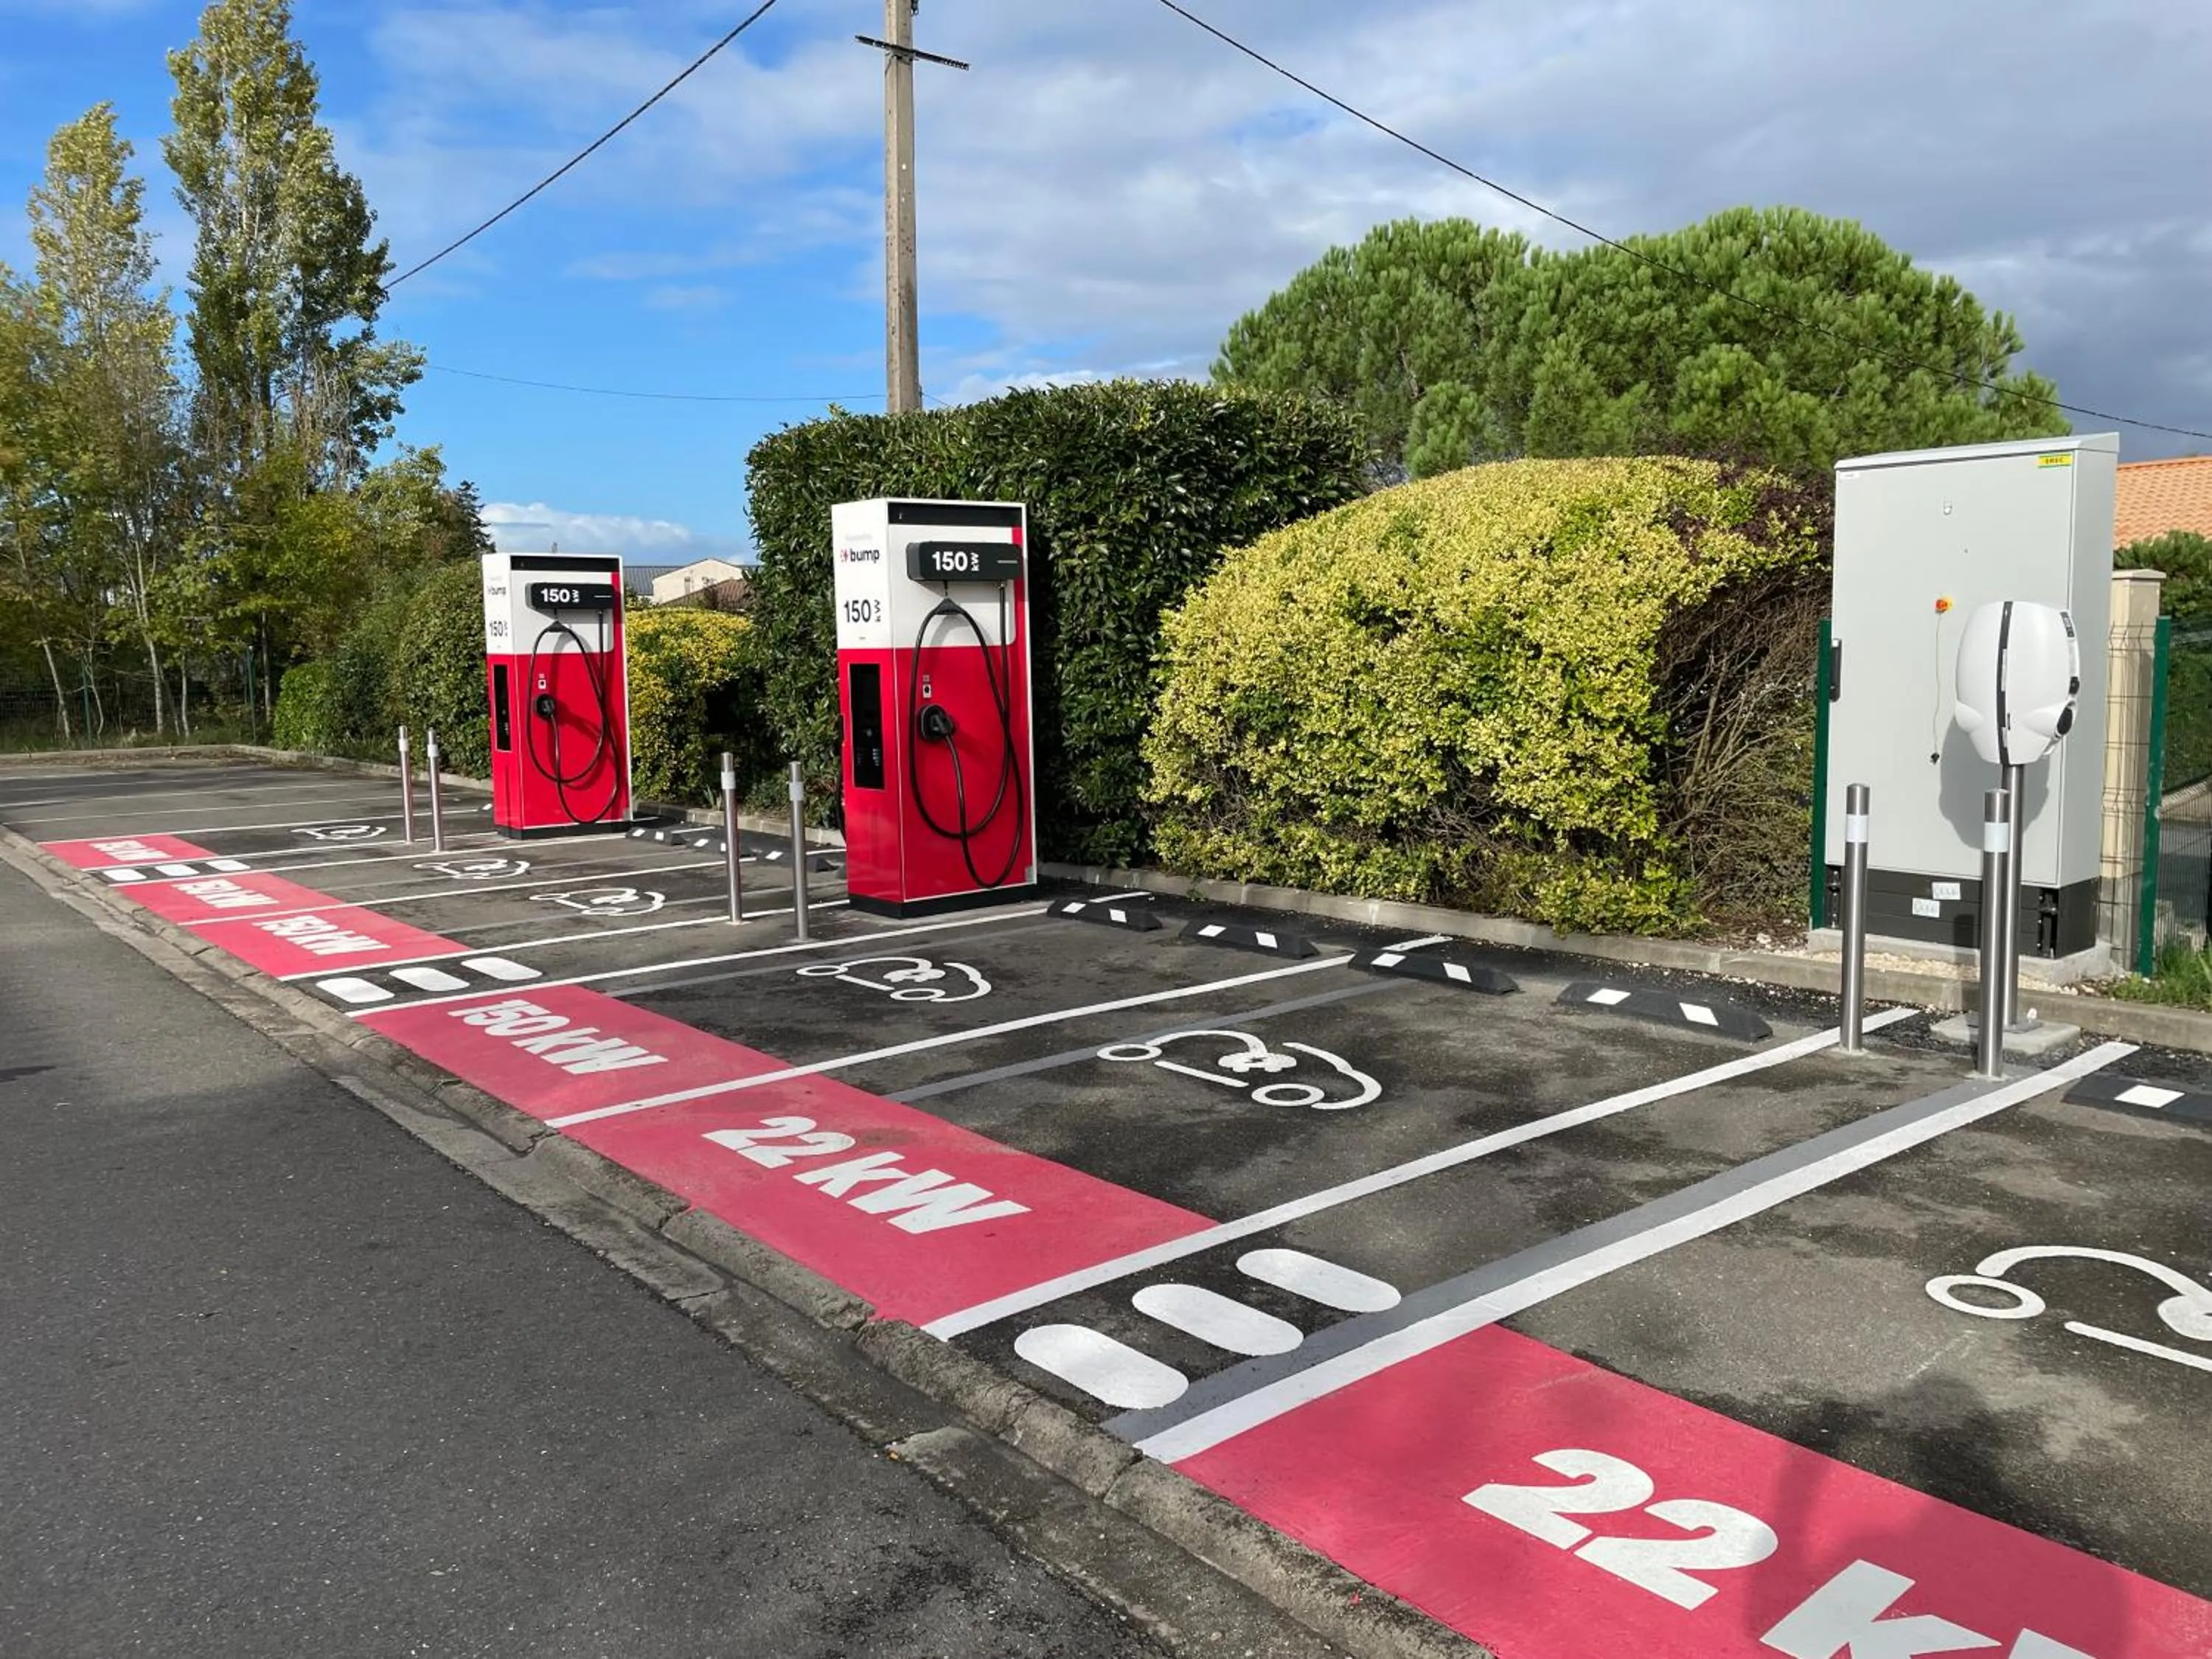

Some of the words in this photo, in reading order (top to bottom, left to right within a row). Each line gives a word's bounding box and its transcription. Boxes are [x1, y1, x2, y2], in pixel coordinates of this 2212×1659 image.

[850, 549, 880, 563] bump
[932, 551, 968, 571] 150
[971, 552, 980, 571] kW
[540, 588, 569, 602] 150
[844, 599, 872, 623] 150
[701, 1116, 857, 1169] 22
[792, 1151, 1032, 1234] kW
[1461, 1448, 1778, 1610] 22
[1759, 1559, 2097, 1659] k
